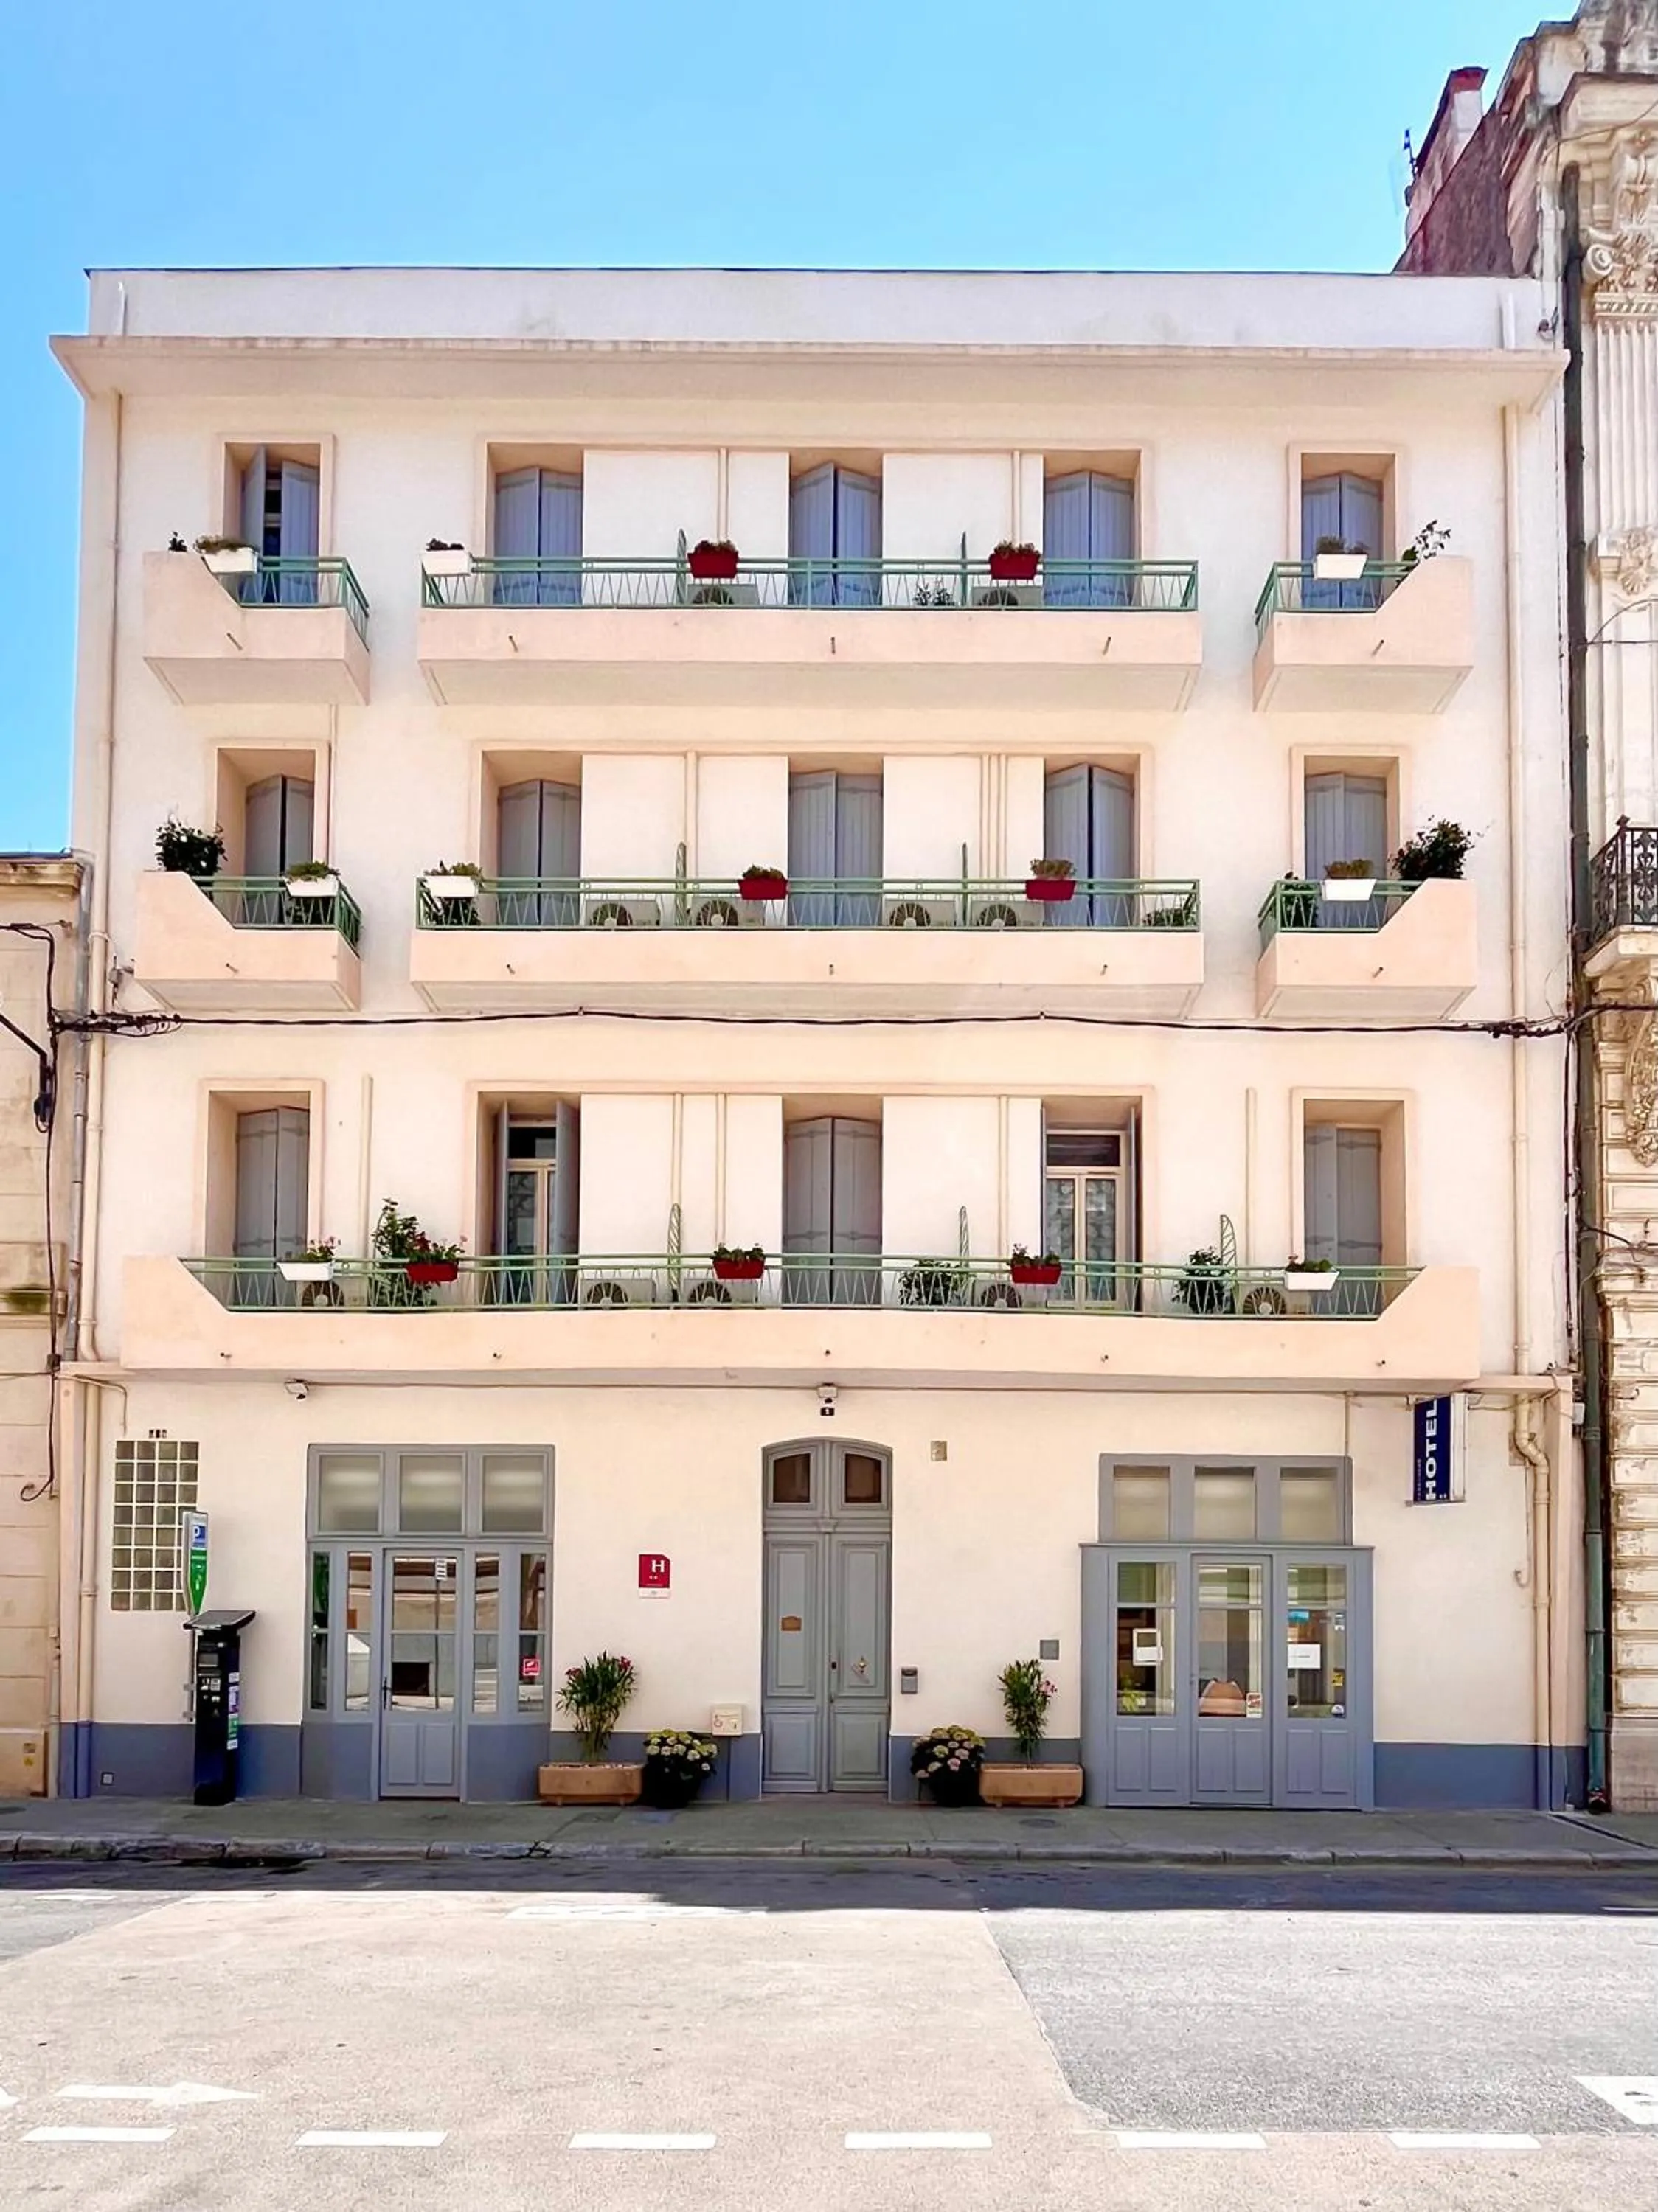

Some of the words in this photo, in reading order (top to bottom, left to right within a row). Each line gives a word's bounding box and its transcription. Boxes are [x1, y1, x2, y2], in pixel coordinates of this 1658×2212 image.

[1426, 1399, 1437, 1500] HOTEL
[192, 1526, 200, 1542] P
[651, 1559, 665, 1573] H
